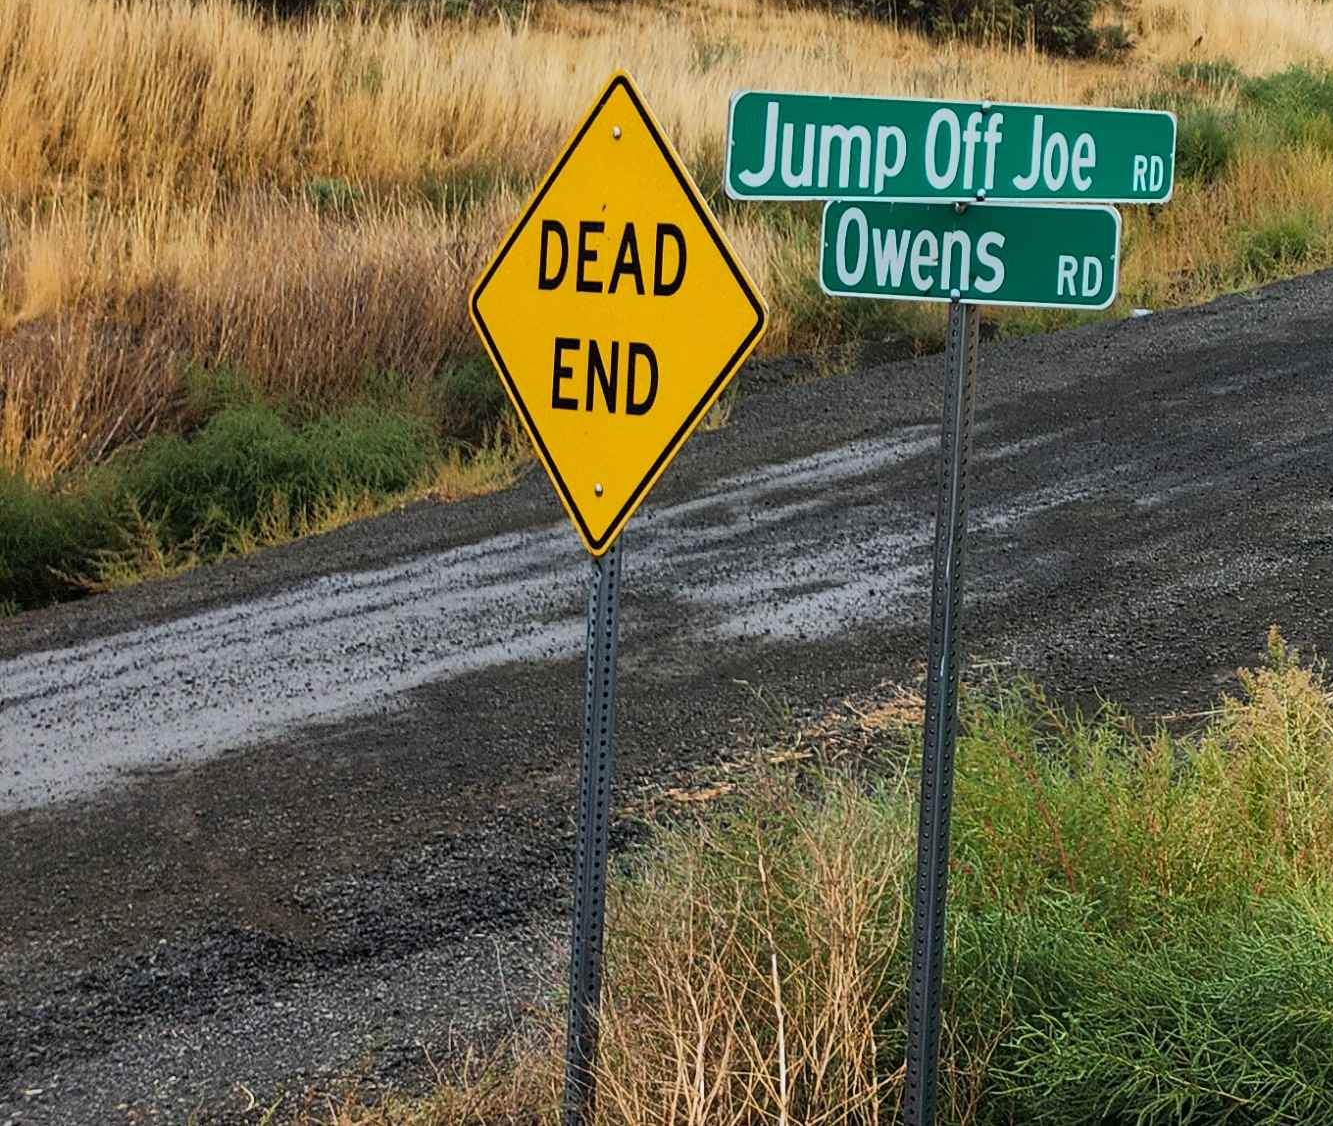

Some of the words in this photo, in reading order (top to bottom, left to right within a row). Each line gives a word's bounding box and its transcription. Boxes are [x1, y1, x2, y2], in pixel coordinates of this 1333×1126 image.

[739, 101, 907, 194] Jump
[925, 108, 1003, 191] Off
[1012, 114, 1096, 192] Joe
[1132, 154, 1164, 193] RD
[537, 219, 687, 297] DEAD
[835, 206, 1005, 294] Owens
[1056, 255, 1102, 298] RD
[551, 336, 659, 416] END
